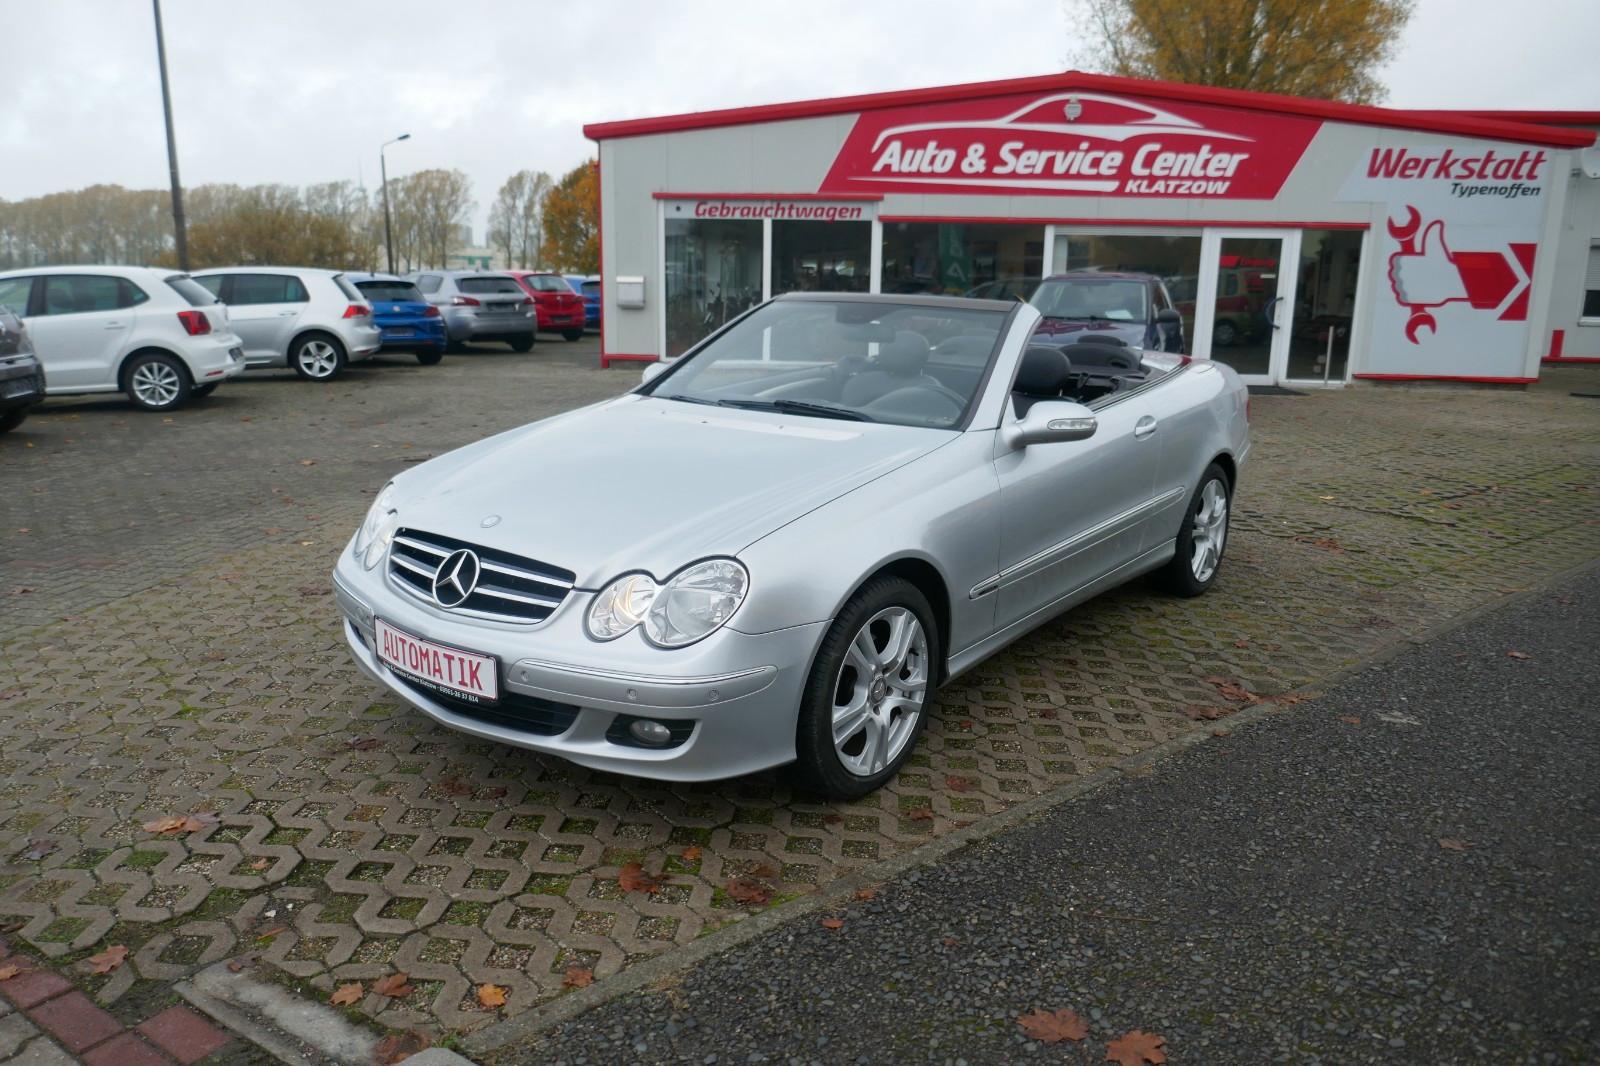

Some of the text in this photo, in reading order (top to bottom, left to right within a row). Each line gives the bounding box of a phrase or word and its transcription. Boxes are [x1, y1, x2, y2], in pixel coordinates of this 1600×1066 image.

[872, 140, 1250, 178] Auto & Service Center
[1367, 147, 1548, 182] Werkstatt
[1124, 179, 1232, 195] KLATZOW
[1450, 182, 1541, 199] Typenoffen
[695, 201, 861, 222] Gebrauchtwagen
[383, 629, 483, 691] AUTOMATIK
